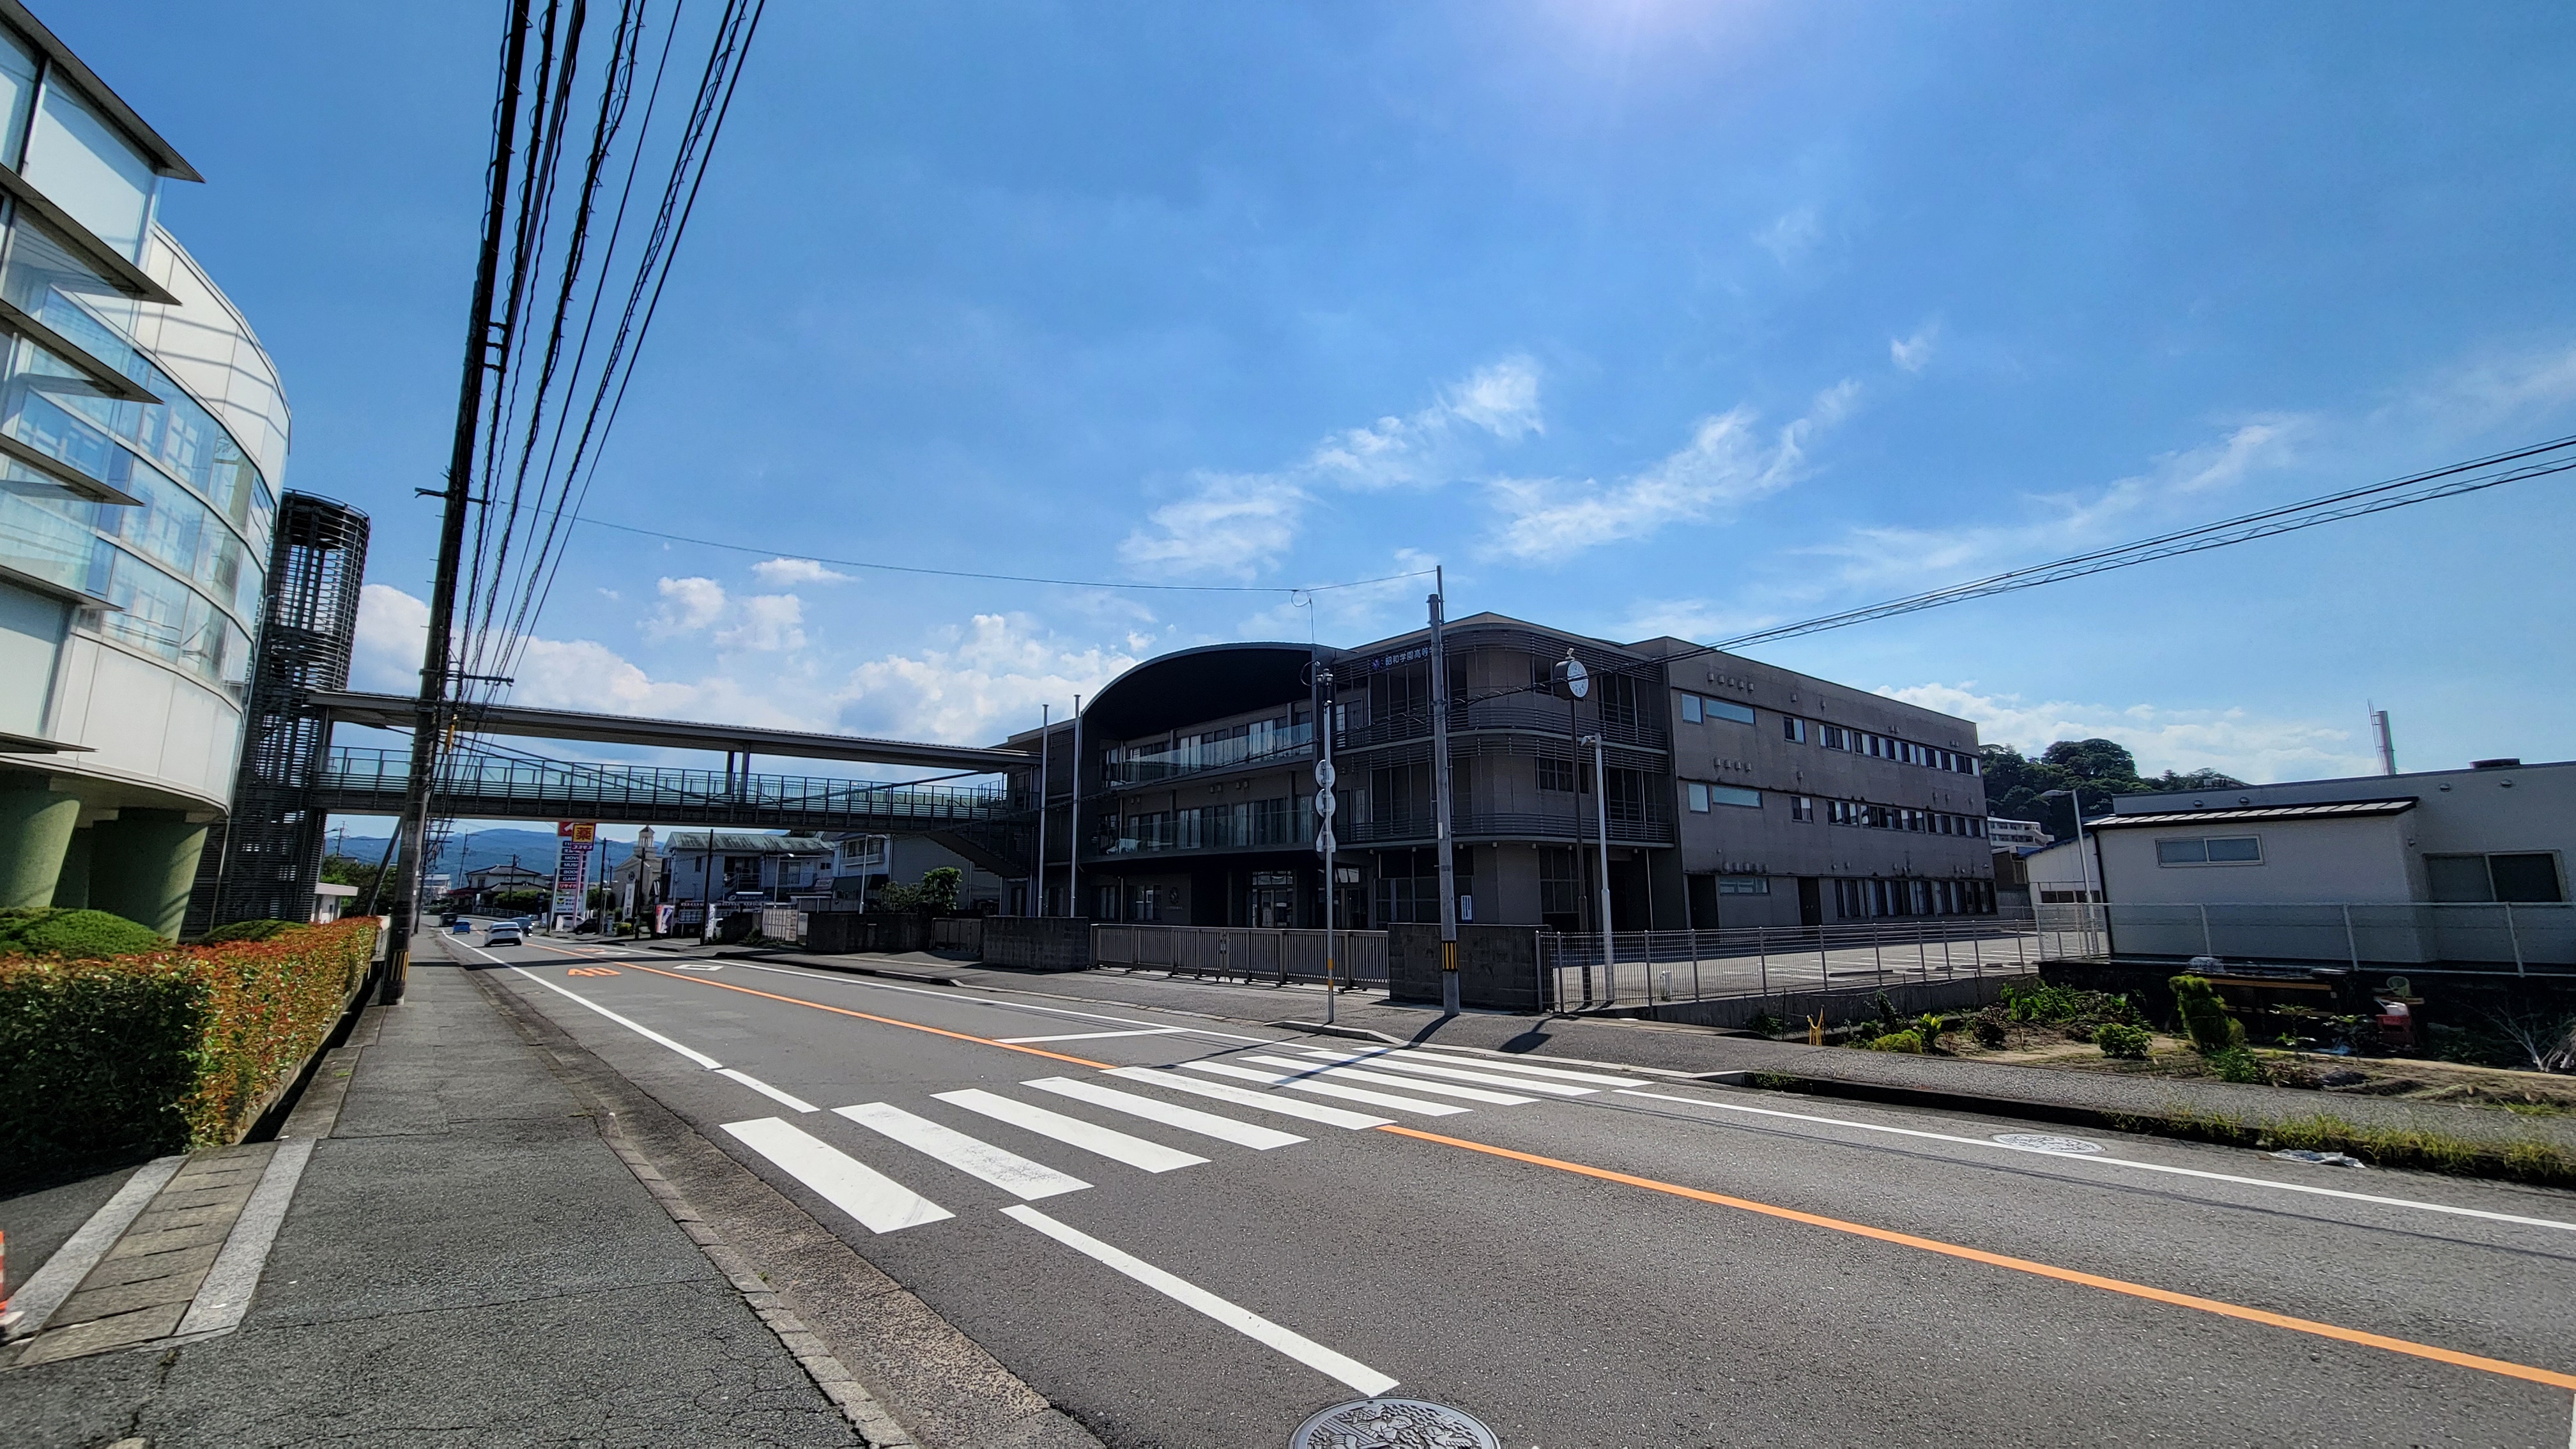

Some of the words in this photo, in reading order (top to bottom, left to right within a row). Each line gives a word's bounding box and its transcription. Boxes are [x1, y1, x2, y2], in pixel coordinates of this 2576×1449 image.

[1385, 643, 1444, 666] 昭和学園高等
[576, 827, 592, 841] 薬
[567, 967, 622, 977] 40
